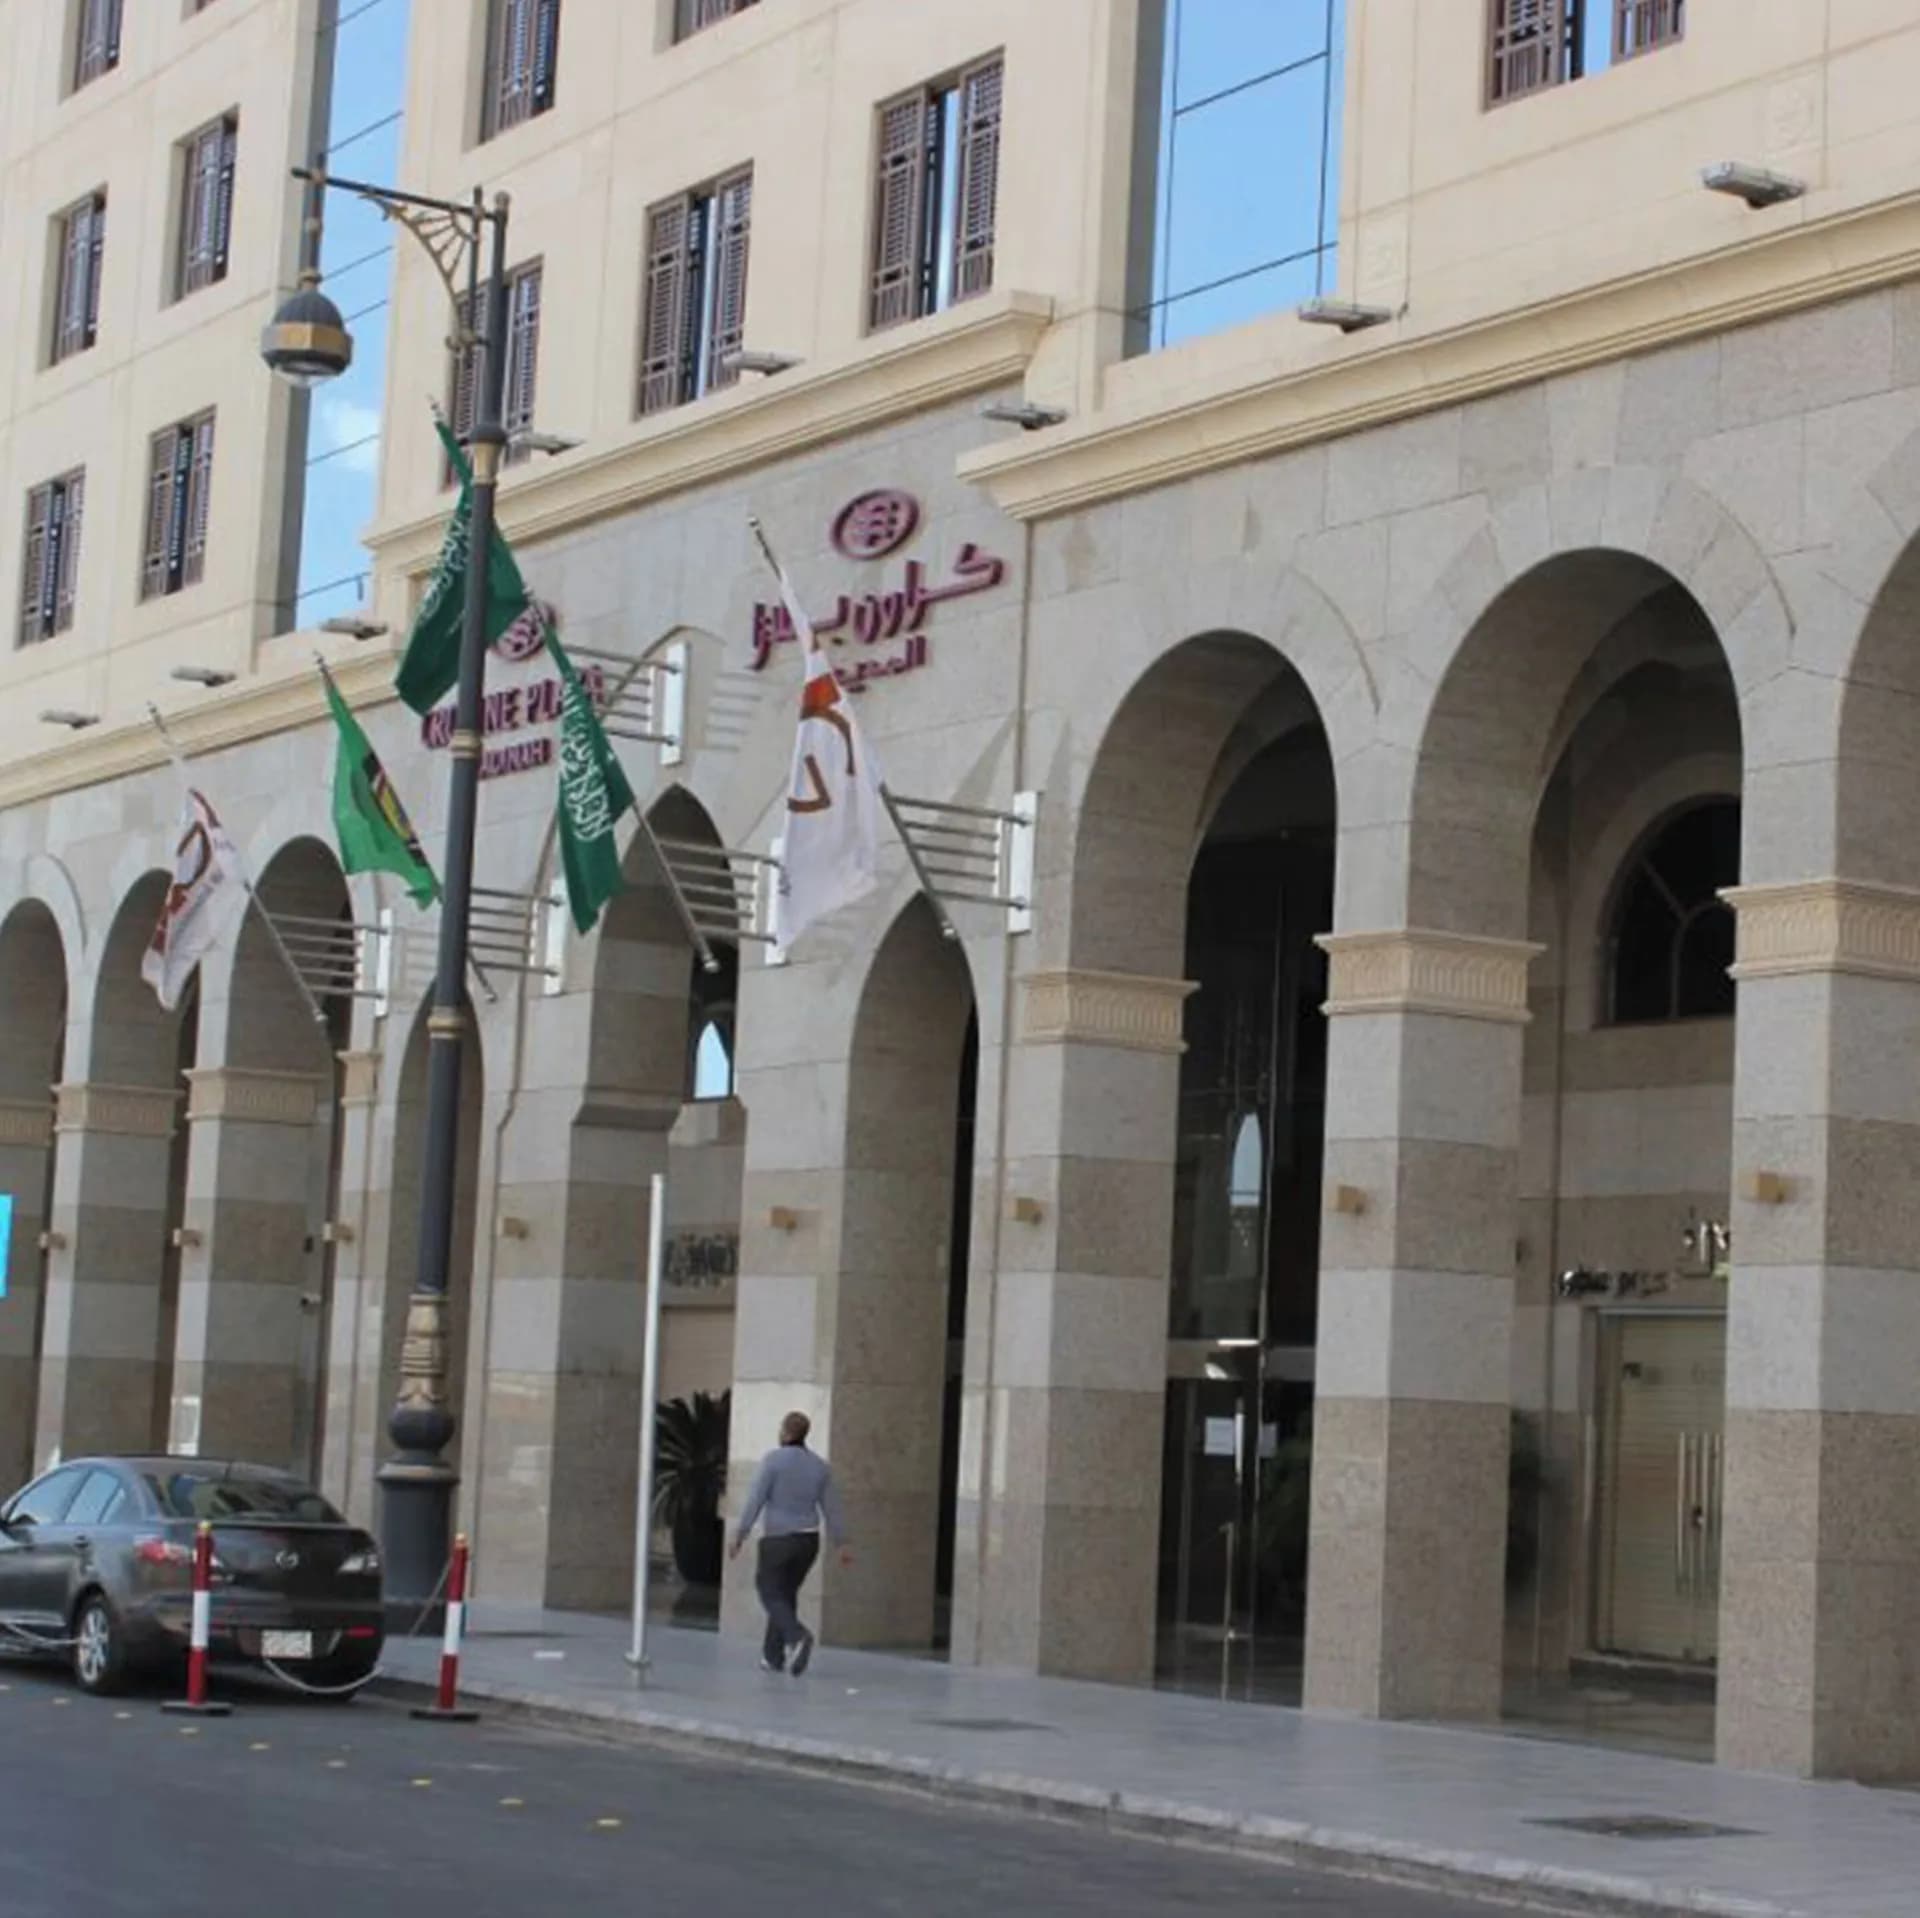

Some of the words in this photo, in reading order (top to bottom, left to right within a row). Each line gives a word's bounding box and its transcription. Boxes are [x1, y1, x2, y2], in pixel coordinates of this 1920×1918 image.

[854, 543, 1004, 646] كراون
[832, 635, 927, 694] المدي
[421, 686, 522, 750] CRONE
[527, 664, 606, 725] PLA
[476, 738, 553, 780] ADINAH
